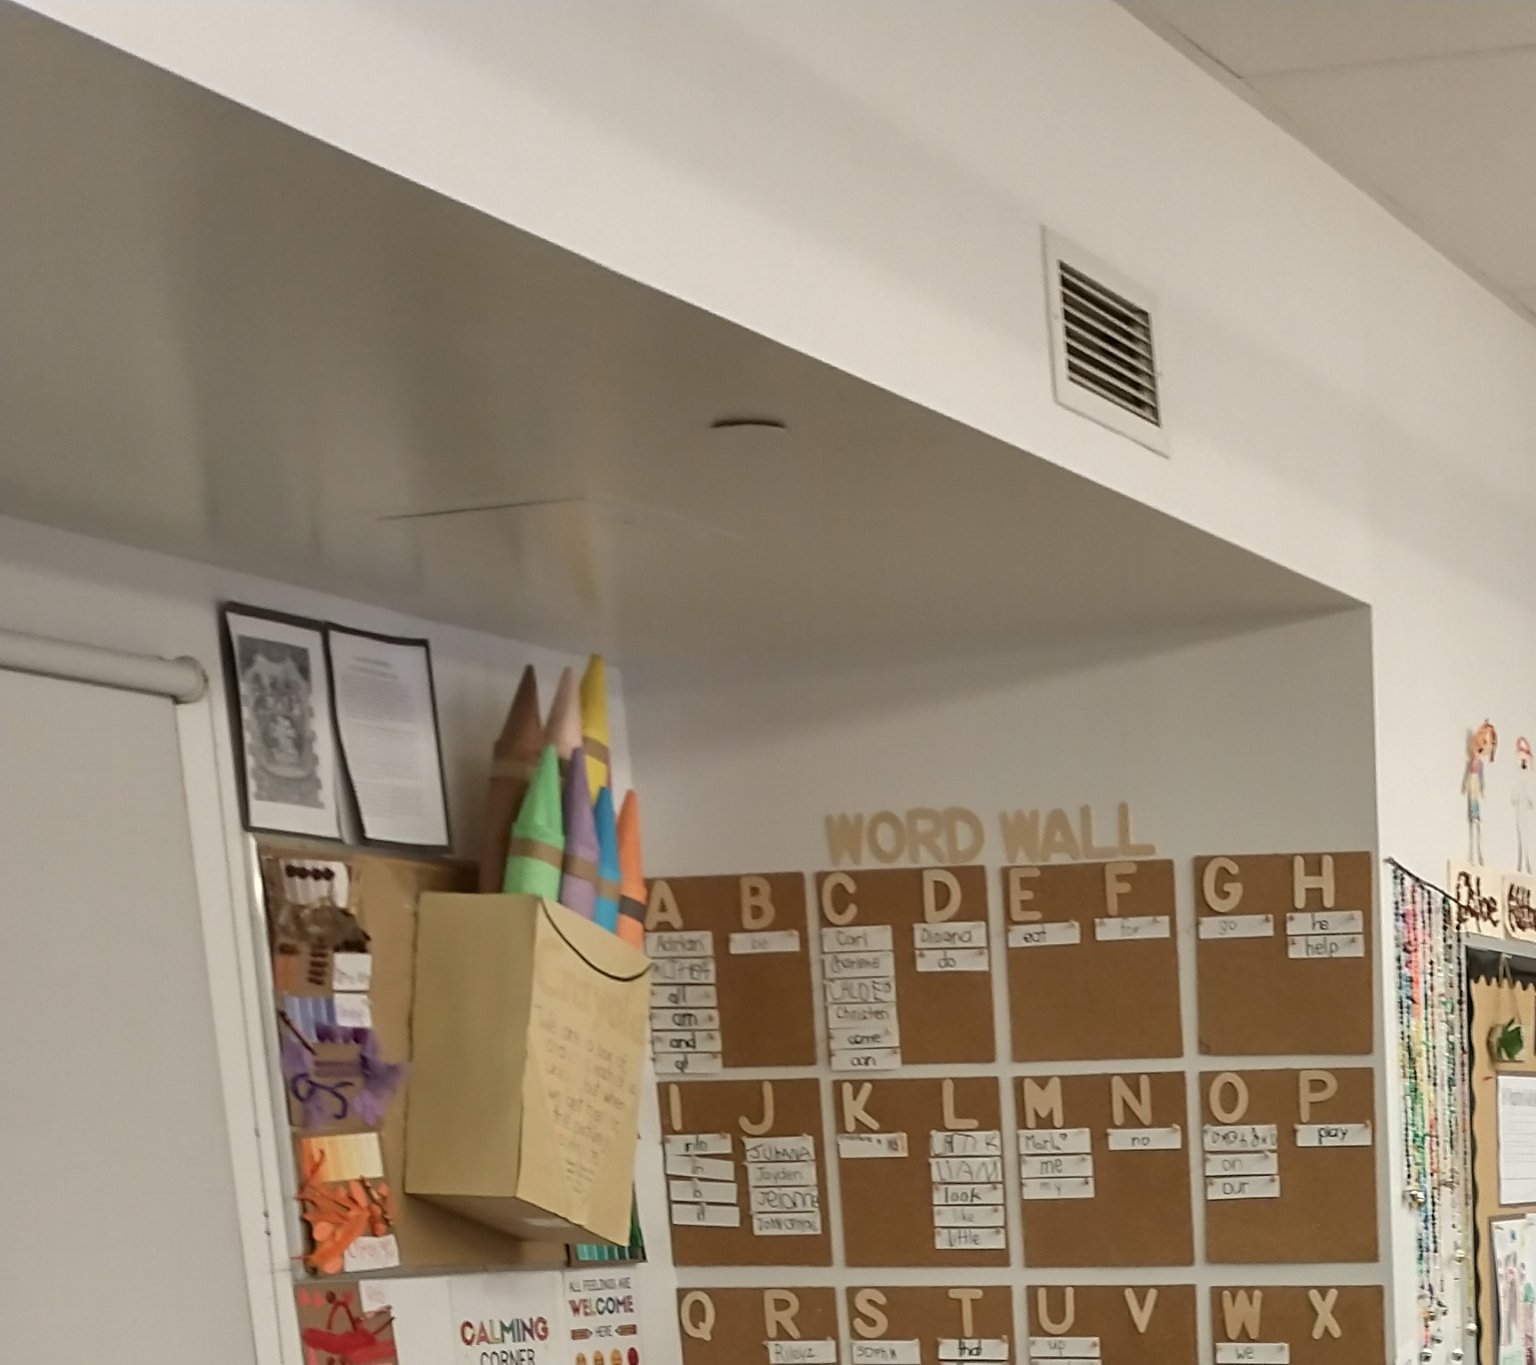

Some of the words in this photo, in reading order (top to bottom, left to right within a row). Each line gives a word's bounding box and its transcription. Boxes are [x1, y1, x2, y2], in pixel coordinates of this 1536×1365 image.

[824, 807, 985, 865] WORD
[999, 802, 1155, 863] WALL
[645, 880, 683, 930] A
[740, 876, 776, 929] B
[821, 872, 858, 926] C
[922, 868, 962, 923] D
[1008, 867, 1043, 922] E
[1104, 862, 1137, 916] F
[1203, 857, 1243, 913] G
[1292, 855, 1335, 909] H
[669, 1083, 682, 1131] I
[738, 1081, 775, 1135] J
[842, 1081, 881, 1132] K
[942, 1079, 979, 1130] L
[1023, 1076, 1064, 1128] M
[1111, 1074, 1151, 1126] N
[1209, 1072, 1249, 1125] O
[1299, 1069, 1338, 1124] P
[459, 1315, 550, 1347] CALMING
[568, 1294, 635, 1319] WELCOME
[680, 1290, 716, 1341] Q
[763, 1289, 800, 1339] R
[853, 1288, 888, 1338] S
[948, 1288, 983, 1337] T
[1037, 1287, 1075, 1335] U
[1124, 1288, 1158, 1333] V
[1222, 1289, 1263, 1341] W
[1308, 1288, 1342, 1340] X
